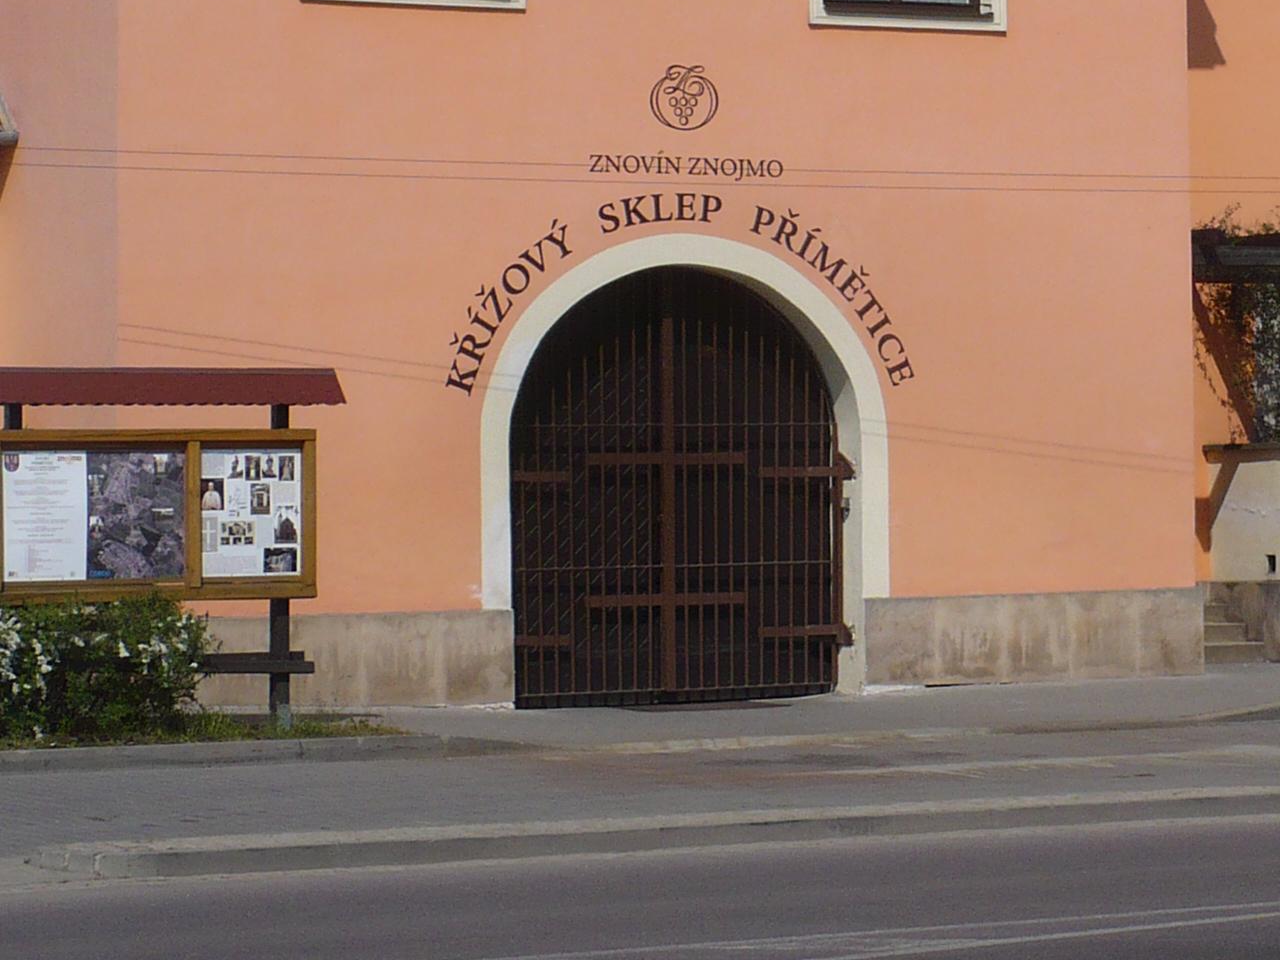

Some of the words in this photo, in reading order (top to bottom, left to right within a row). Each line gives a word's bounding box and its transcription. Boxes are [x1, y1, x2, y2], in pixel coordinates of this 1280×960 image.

[588, 150, 681, 175] ZNOVÍN
[687, 156, 784, 181] ZNOJMO
[445, 220, 573, 397] KŘÍŽOVÝ
[598, 193, 722, 234] SKLEP
[750, 205, 914, 387] PŘÍMĚTICE
